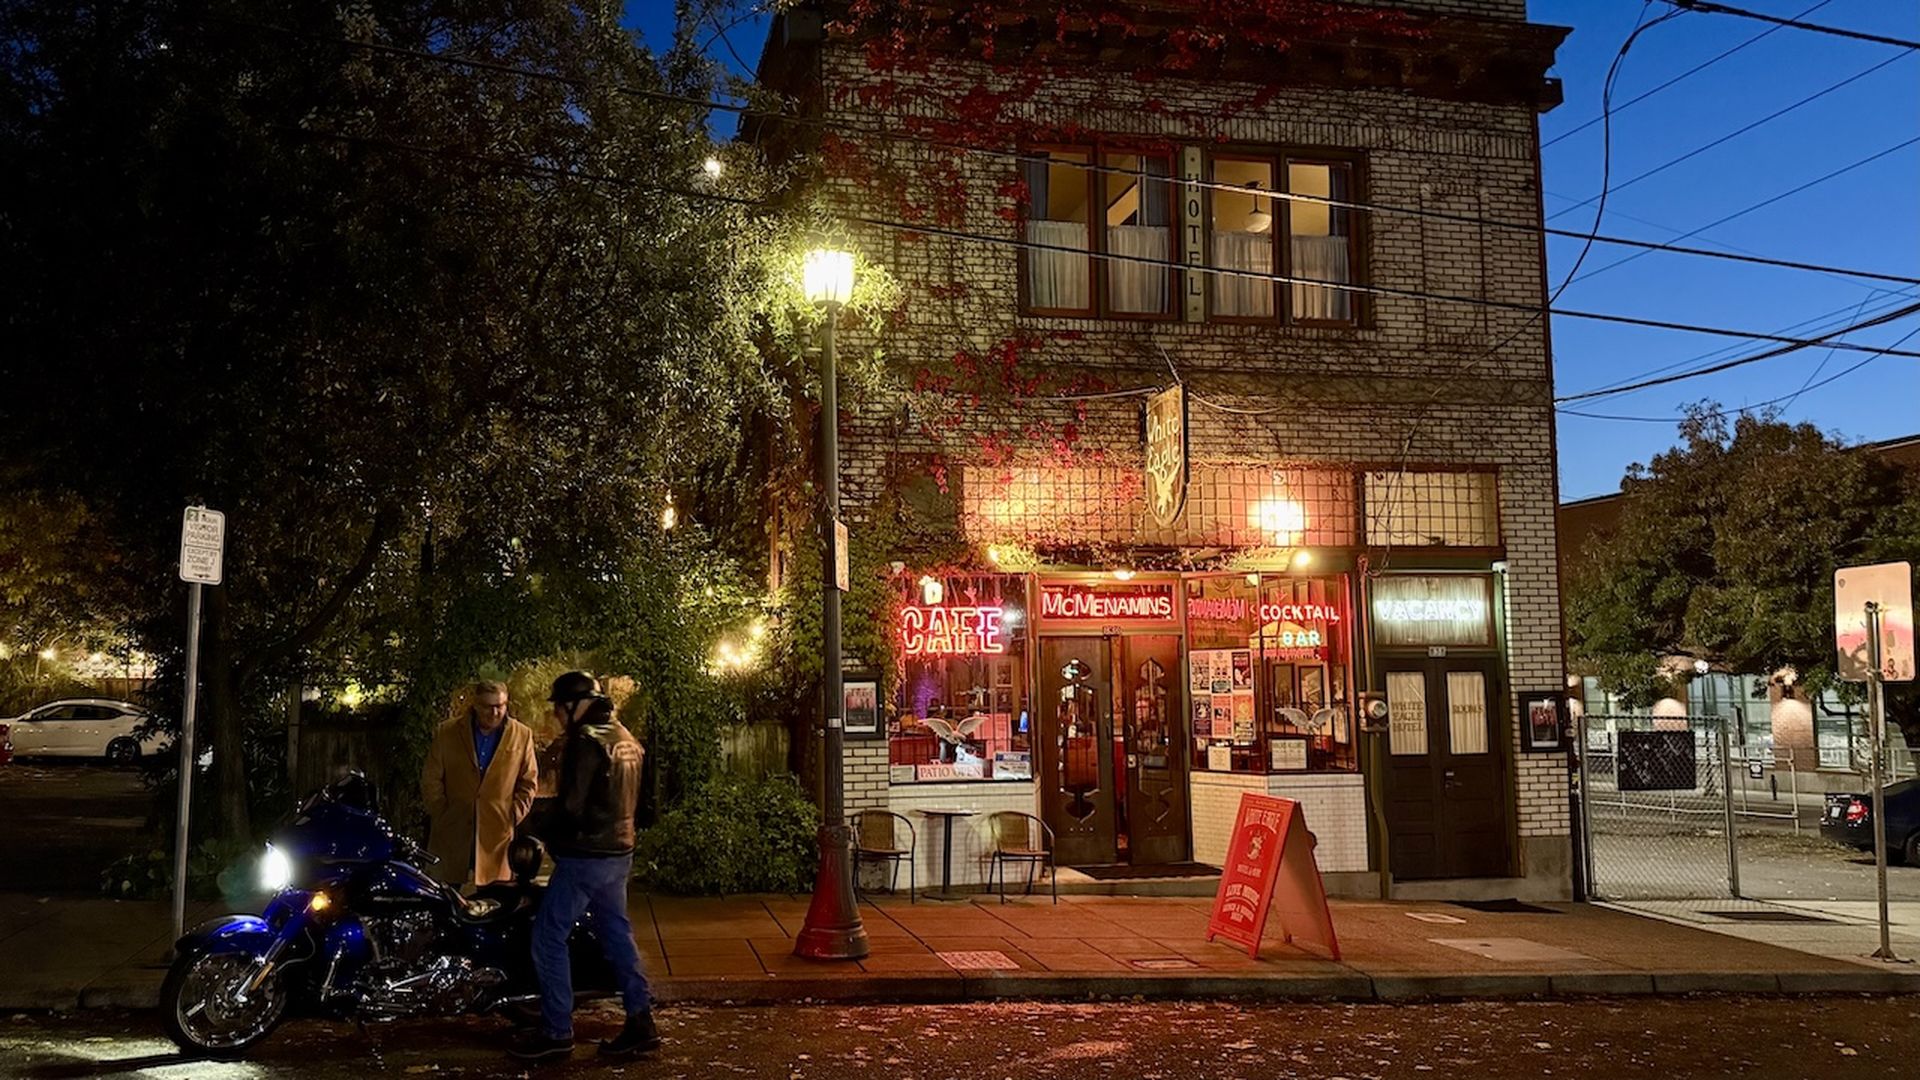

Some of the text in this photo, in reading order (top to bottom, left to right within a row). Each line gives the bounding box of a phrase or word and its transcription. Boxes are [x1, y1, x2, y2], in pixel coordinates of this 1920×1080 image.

[1188, 173, 1201, 296] HOTEL
[1147, 444, 1180, 482] Eagle
[1260, 604, 1340, 621] COCKTAIL
[1378, 600, 1482, 621] VACANCY
[901, 606, 1003, 654] CAFE
[1282, 631, 1321, 646] BAR
[1391, 702, 1424, 711] WHITE
[1452, 704, 1484, 714] ROOMS
[1392, 711, 1424, 721] EAGLE
[1393, 722, 1424, 732] HOTEL
[920, 767, 950, 778] PATIO
